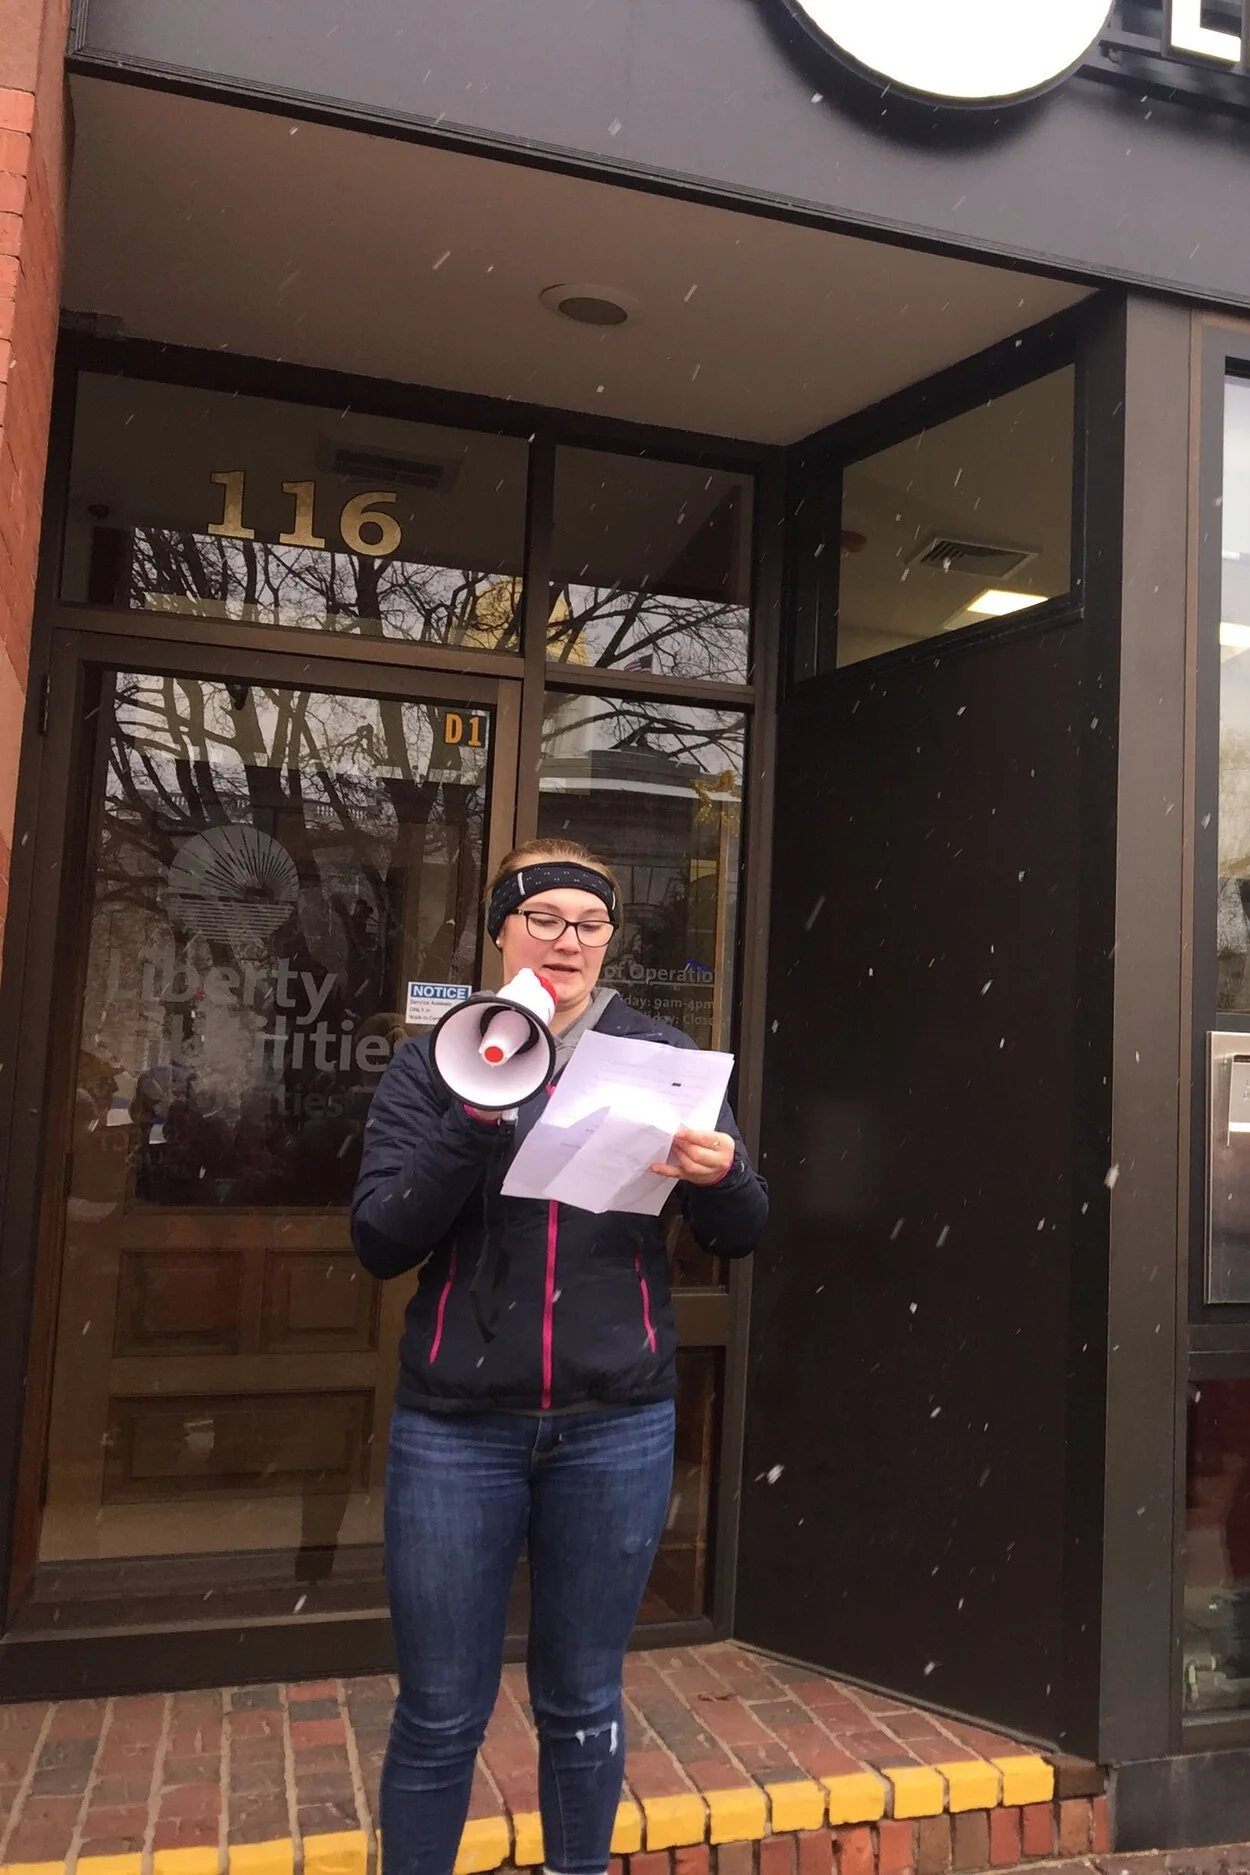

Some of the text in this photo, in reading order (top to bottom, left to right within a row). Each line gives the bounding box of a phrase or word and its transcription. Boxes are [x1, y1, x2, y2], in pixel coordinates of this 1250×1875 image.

[207, 470, 402, 557] 116
[106, 946, 338, 1025] Liberty
[413, 985, 466, 999] NOTICE
[628, 962, 714, 986] Operatio
